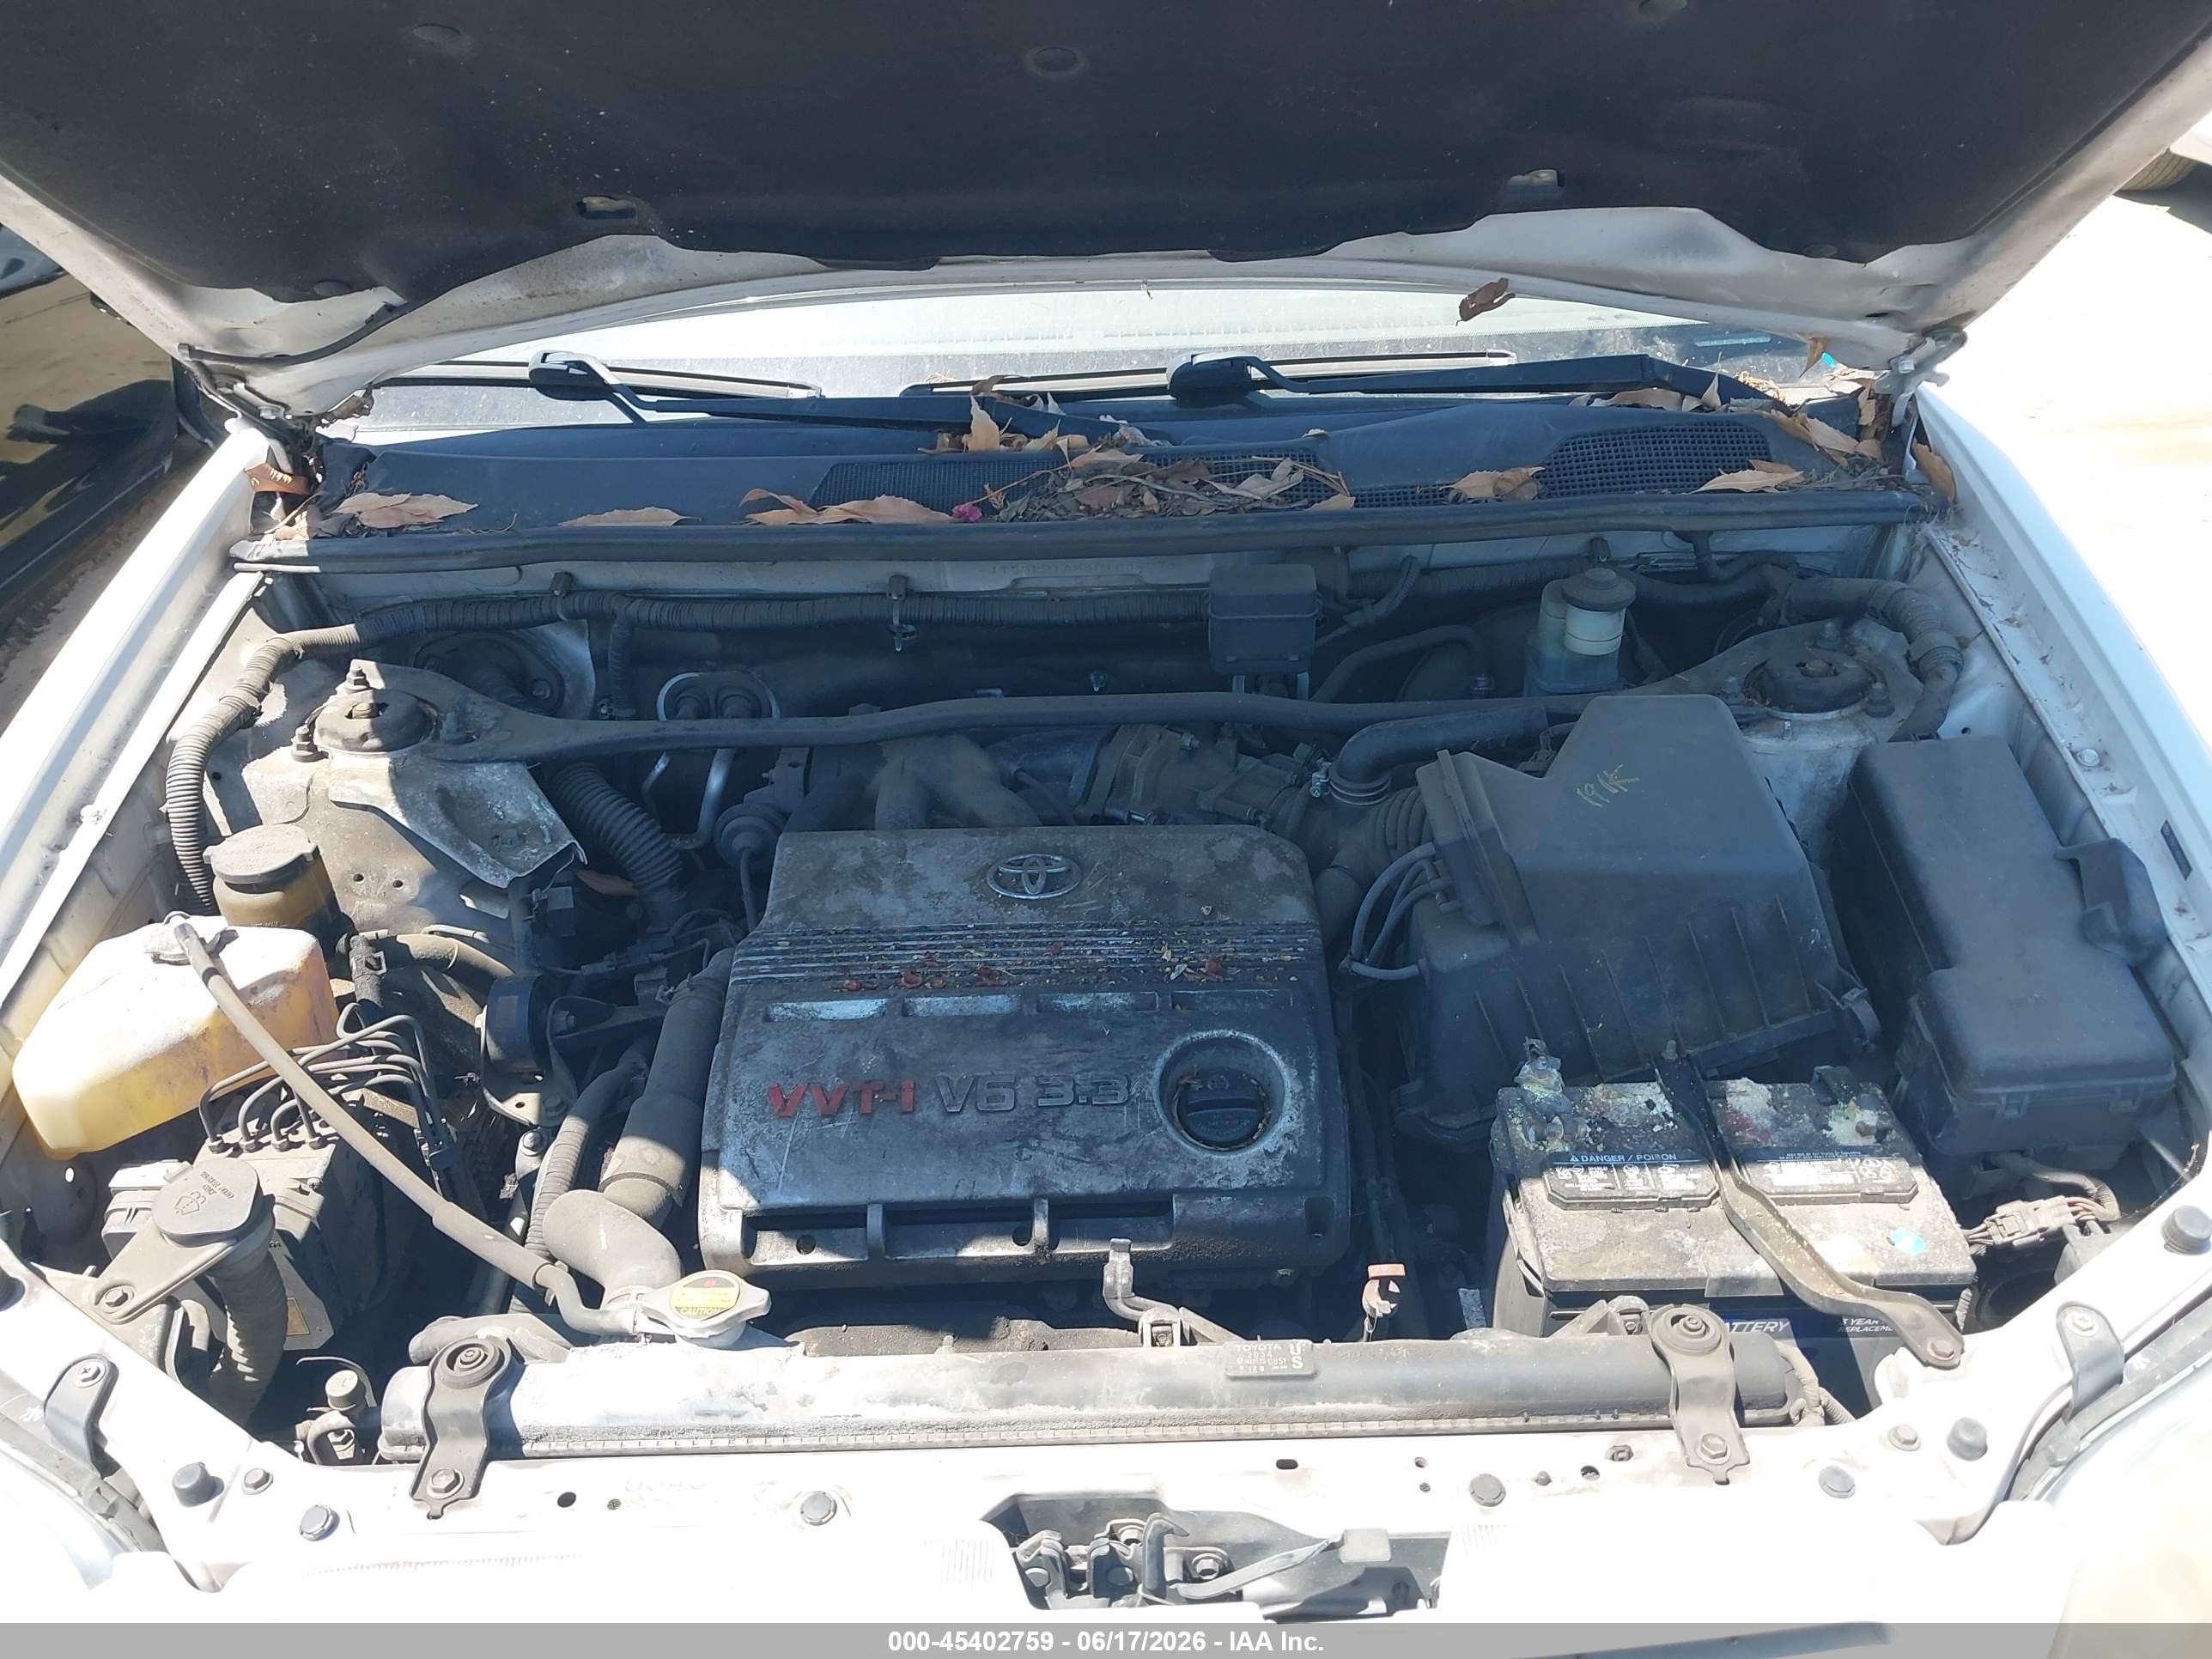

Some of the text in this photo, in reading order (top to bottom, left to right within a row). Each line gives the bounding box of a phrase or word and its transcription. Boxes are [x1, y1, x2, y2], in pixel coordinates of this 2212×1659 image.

[933, 1074, 1018, 1113] V6
[1036, 1073, 1130, 1108] 3.3
[680, 1307, 722, 1316] CAUTION
[1723, 1321, 1791, 1333] ATTERY
[1237, 1343, 1283, 1352] TOYOTA
